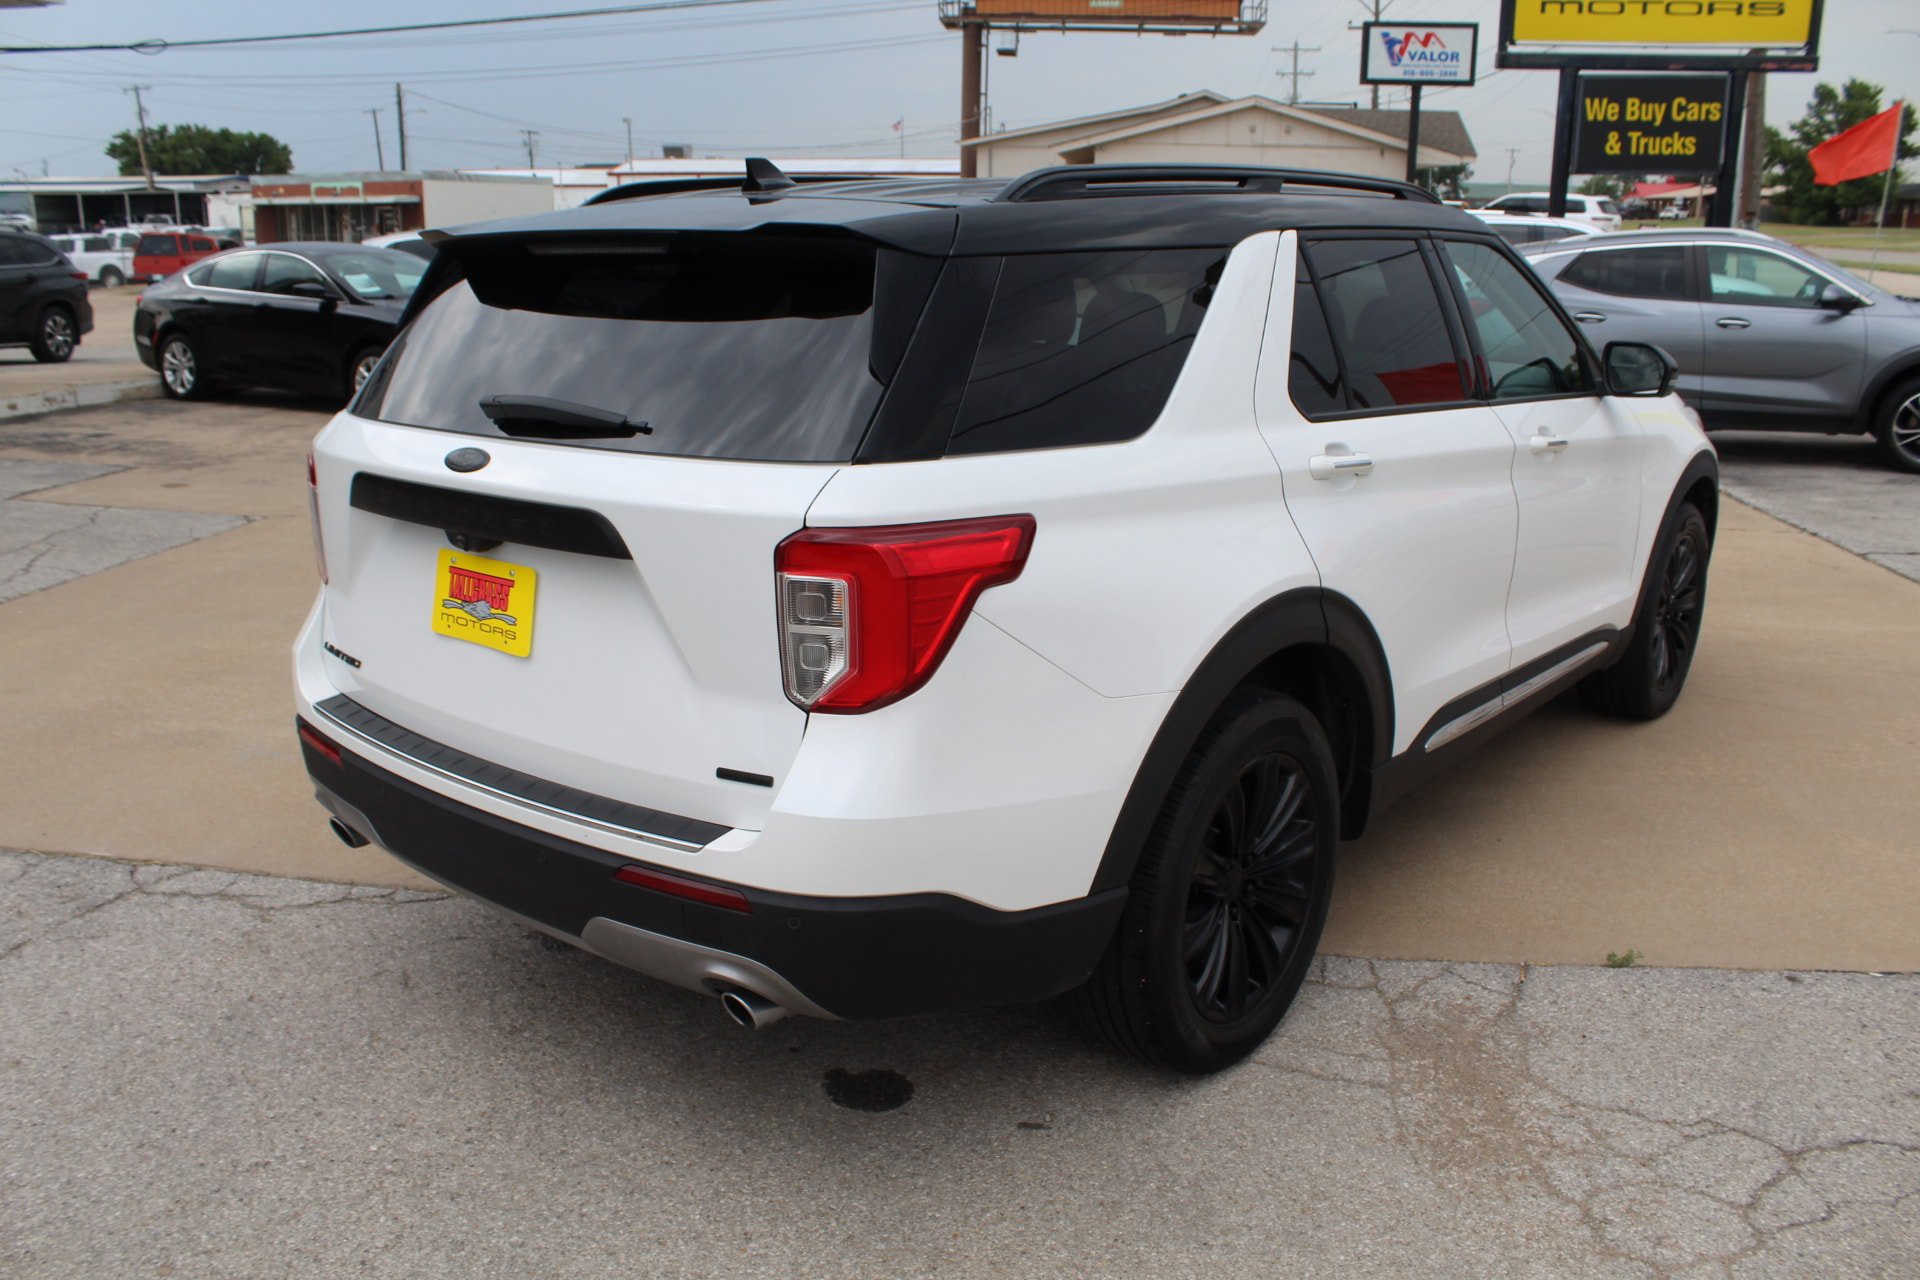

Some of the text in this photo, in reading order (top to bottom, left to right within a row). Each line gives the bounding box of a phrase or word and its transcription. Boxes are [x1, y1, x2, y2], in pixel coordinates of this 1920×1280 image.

[1540, 0, 1785, 16] MOTORS
[1408, 50, 1460, 62] VALOR
[1585, 96, 1722, 127] We Buy Cars
[1605, 131, 1697, 155] & Trucks
[441, 612, 517, 641] MOTORS
